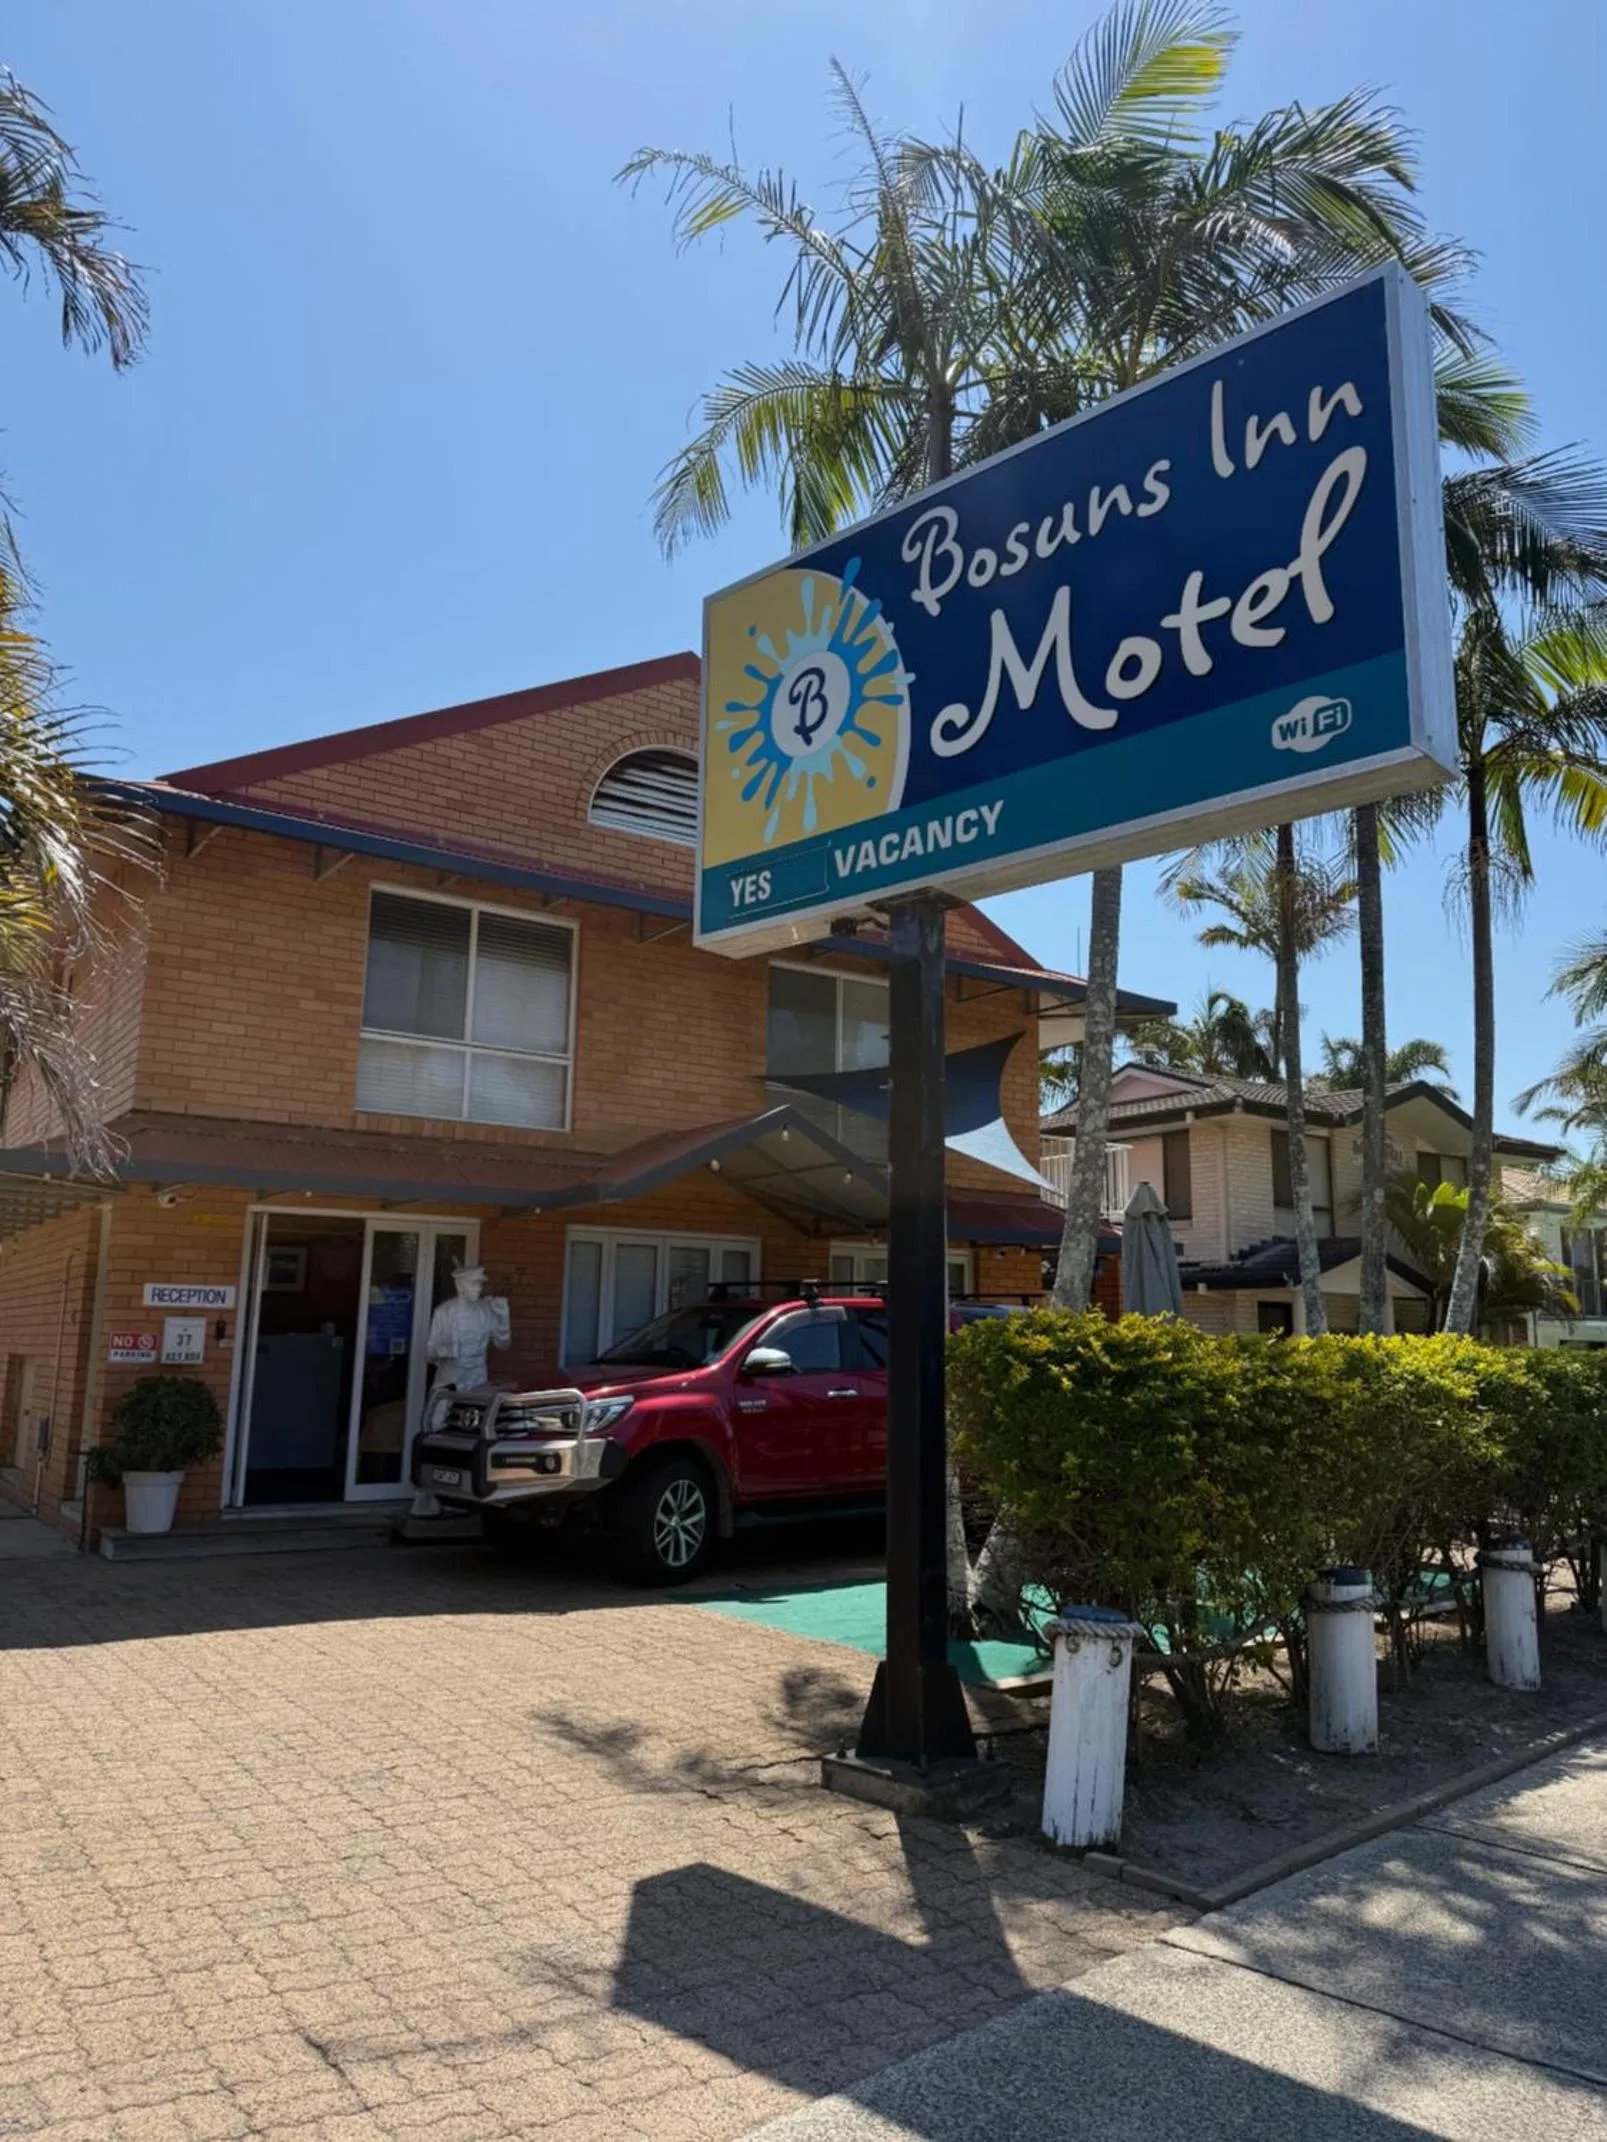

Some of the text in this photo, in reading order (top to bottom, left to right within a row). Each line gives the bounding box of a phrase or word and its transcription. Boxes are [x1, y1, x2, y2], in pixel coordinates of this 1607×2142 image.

[903, 380, 1363, 615] Bosuns Inn
[931, 446, 1366, 757] Motel
[788, 667, 828, 746] B
[731, 800, 1004, 907] YES VACANCY
[113, 1335, 133, 1347] NO
[151, 1287, 226, 1304] RECEPTION
